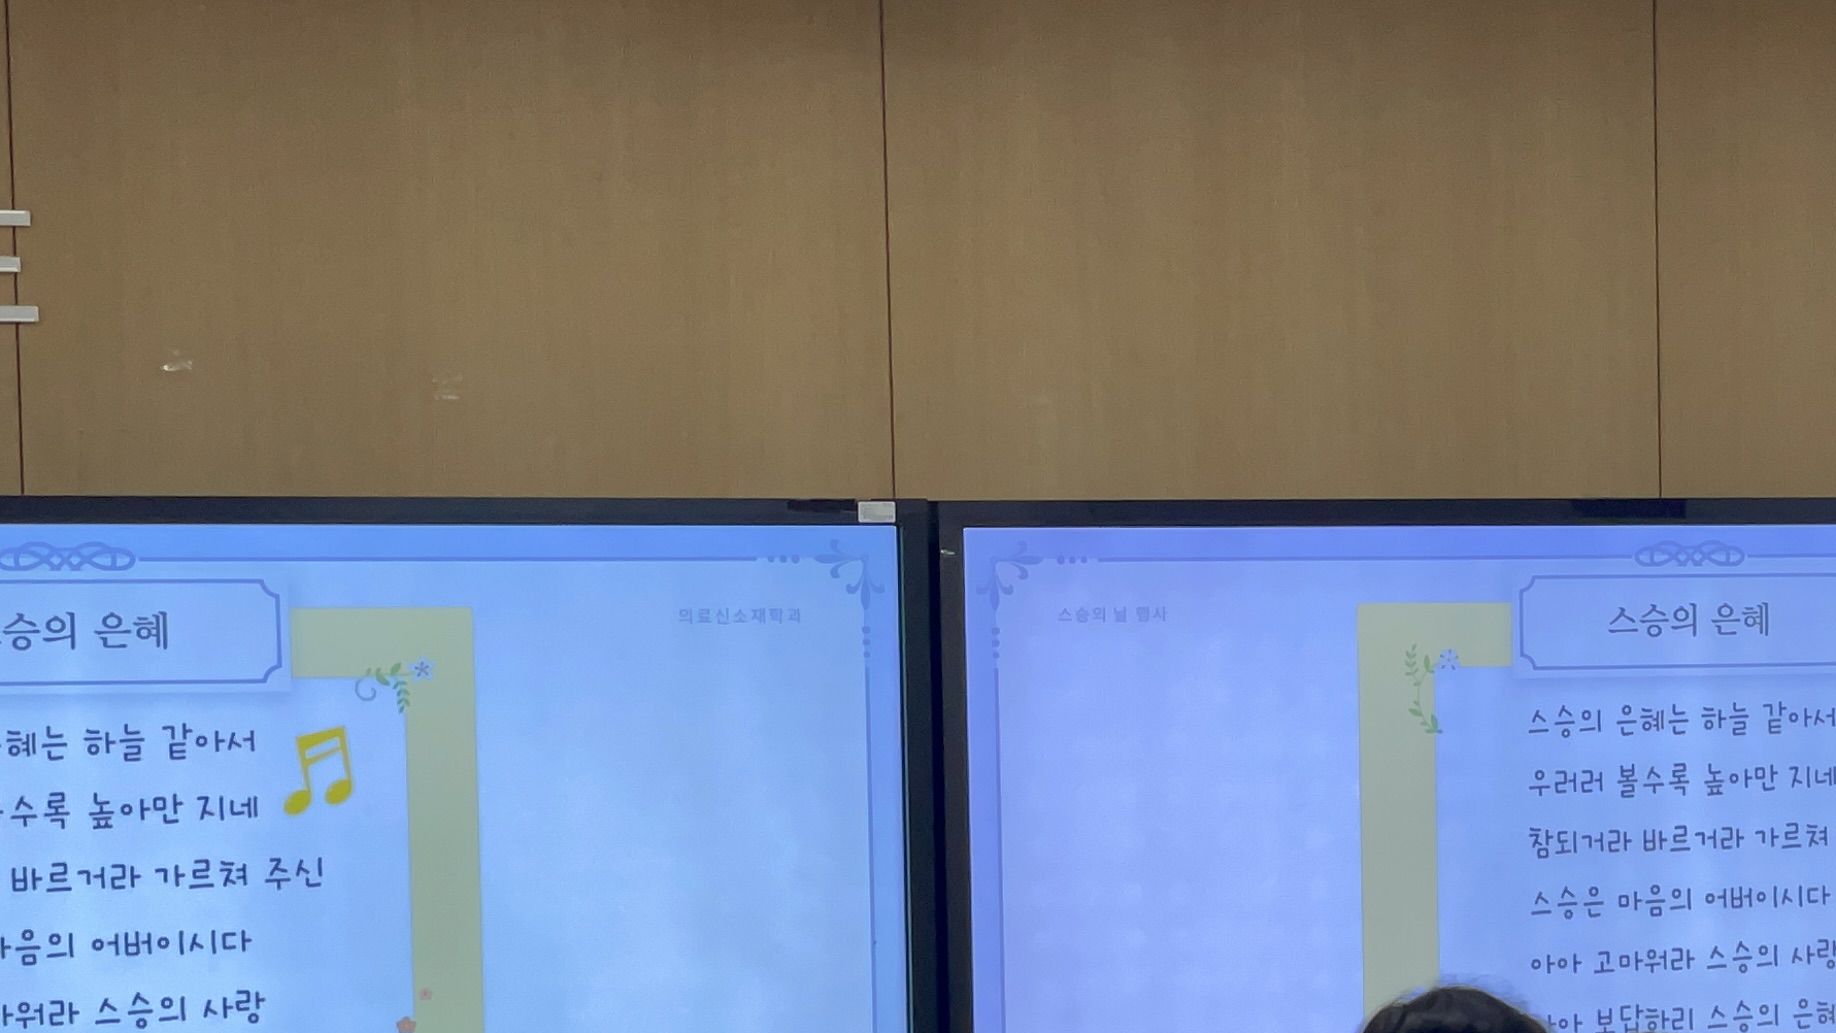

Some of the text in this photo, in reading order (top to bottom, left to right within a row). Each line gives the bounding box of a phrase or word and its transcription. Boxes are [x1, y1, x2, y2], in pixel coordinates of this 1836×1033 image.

[0, 610, 168, 651] 승의 은혜
[679, 607, 801, 625] 의료신소재학과
[1058, 606, 1106, 623] 스승의
[1608, 601, 1770, 637] 스승의 은혜
[1528, 701, 1836, 738] 스승의 은혜는 하늘 같아서
[0, 722, 256, 762] 혜는 하늘 같아서
[1528, 768, 1604, 797] 우러러
[1617, 762, 1690, 798] 볼수록
[1704, 763, 1778, 797] 높아만
[0, 792, 259, 830] 수록 높아만 지네
[1528, 827, 1633, 859] 참되거라
[1642, 824, 1745, 853] 바르거라
[1755, 822, 1829, 850] 가르쳐
[11, 857, 323, 892] 바르거라 가르쳐 주신
[1531, 884, 1831, 920] 스승은 마음의 어버이시다
[91, 930, 252, 956] 어버이시다
[1531, 953, 1582, 974] 아아
[1593, 947, 1695, 974] 고마워라
[1706, 941, 1779, 974] 스승의
[95, 992, 186, 1029] 스승의
[203, 990, 266, 1024] 사랑
[1707, 1000, 1779, 1033] 스승의
